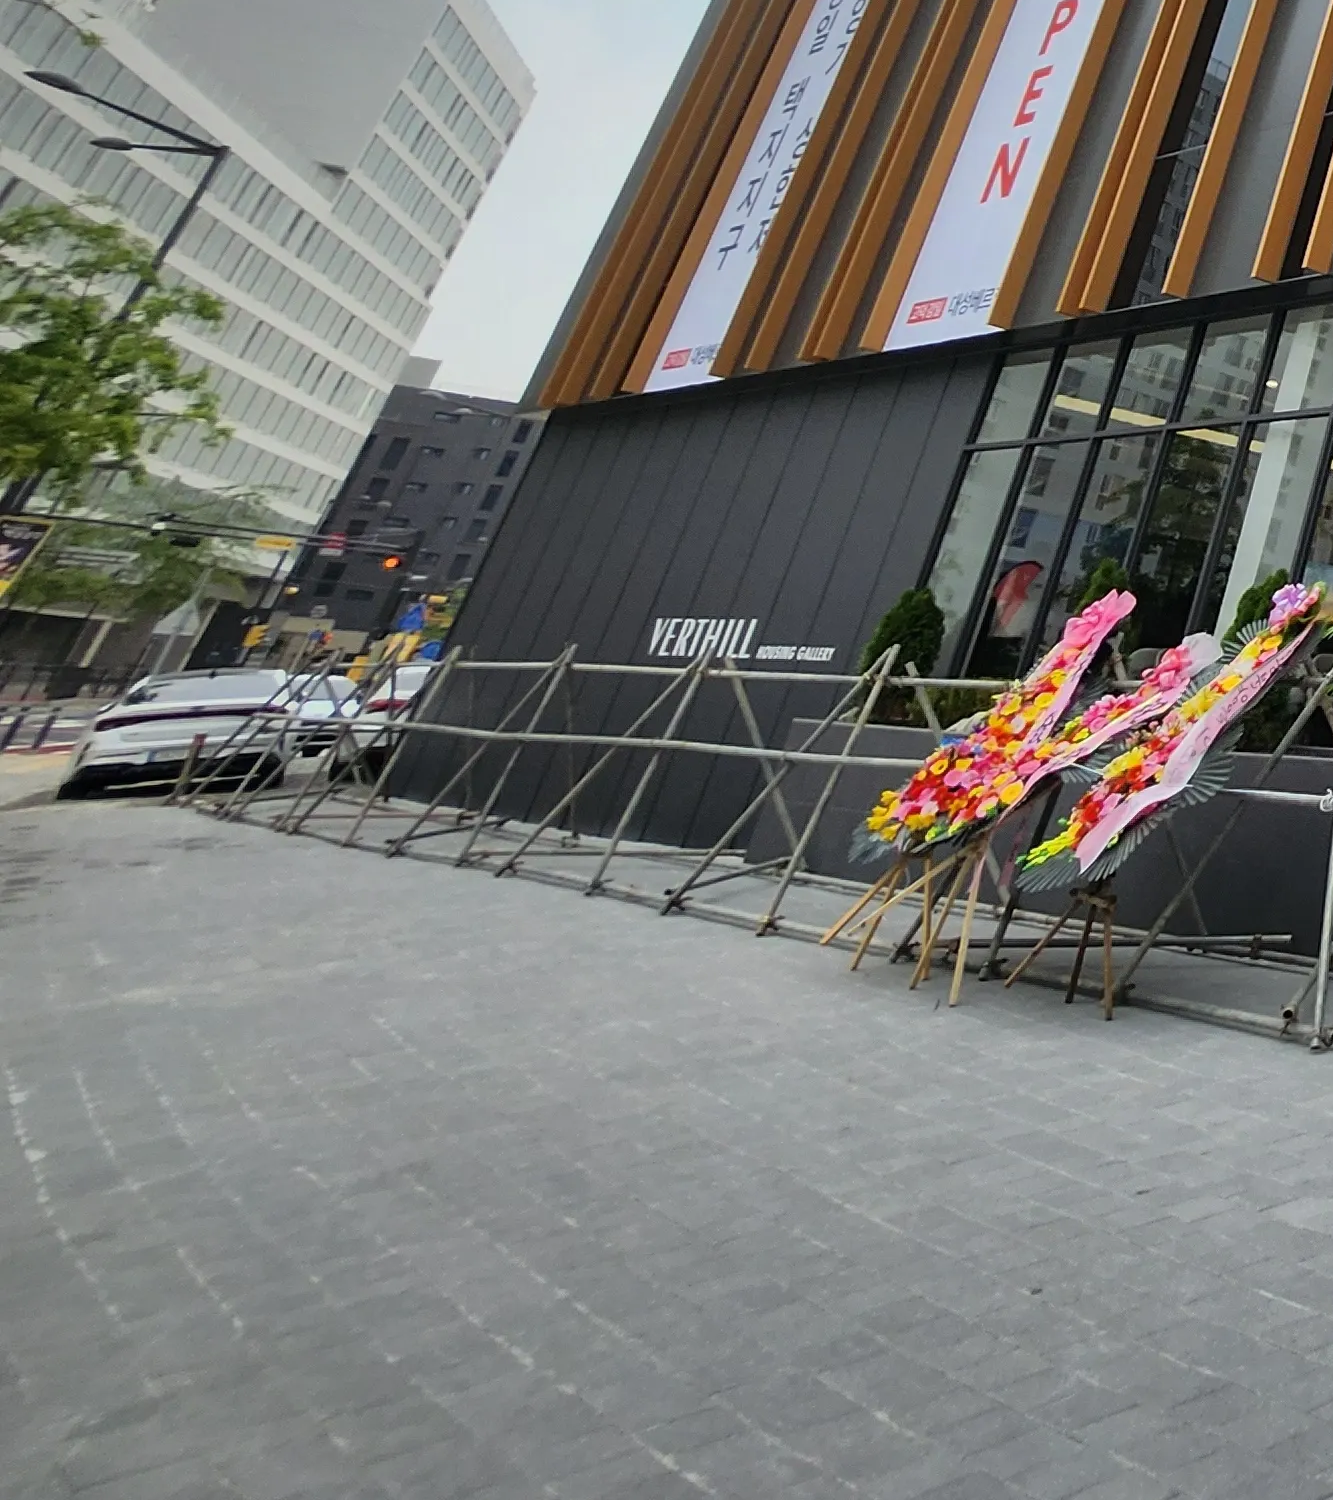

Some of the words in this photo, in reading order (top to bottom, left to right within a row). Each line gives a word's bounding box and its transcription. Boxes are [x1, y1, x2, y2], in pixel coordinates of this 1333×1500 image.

[717, 75, 811, 272] 택지지구
[948, 287, 1000, 316] 대성베르
[647, 617, 759, 660] VERTHILL
[797, 646, 836, 662] GALLERY
